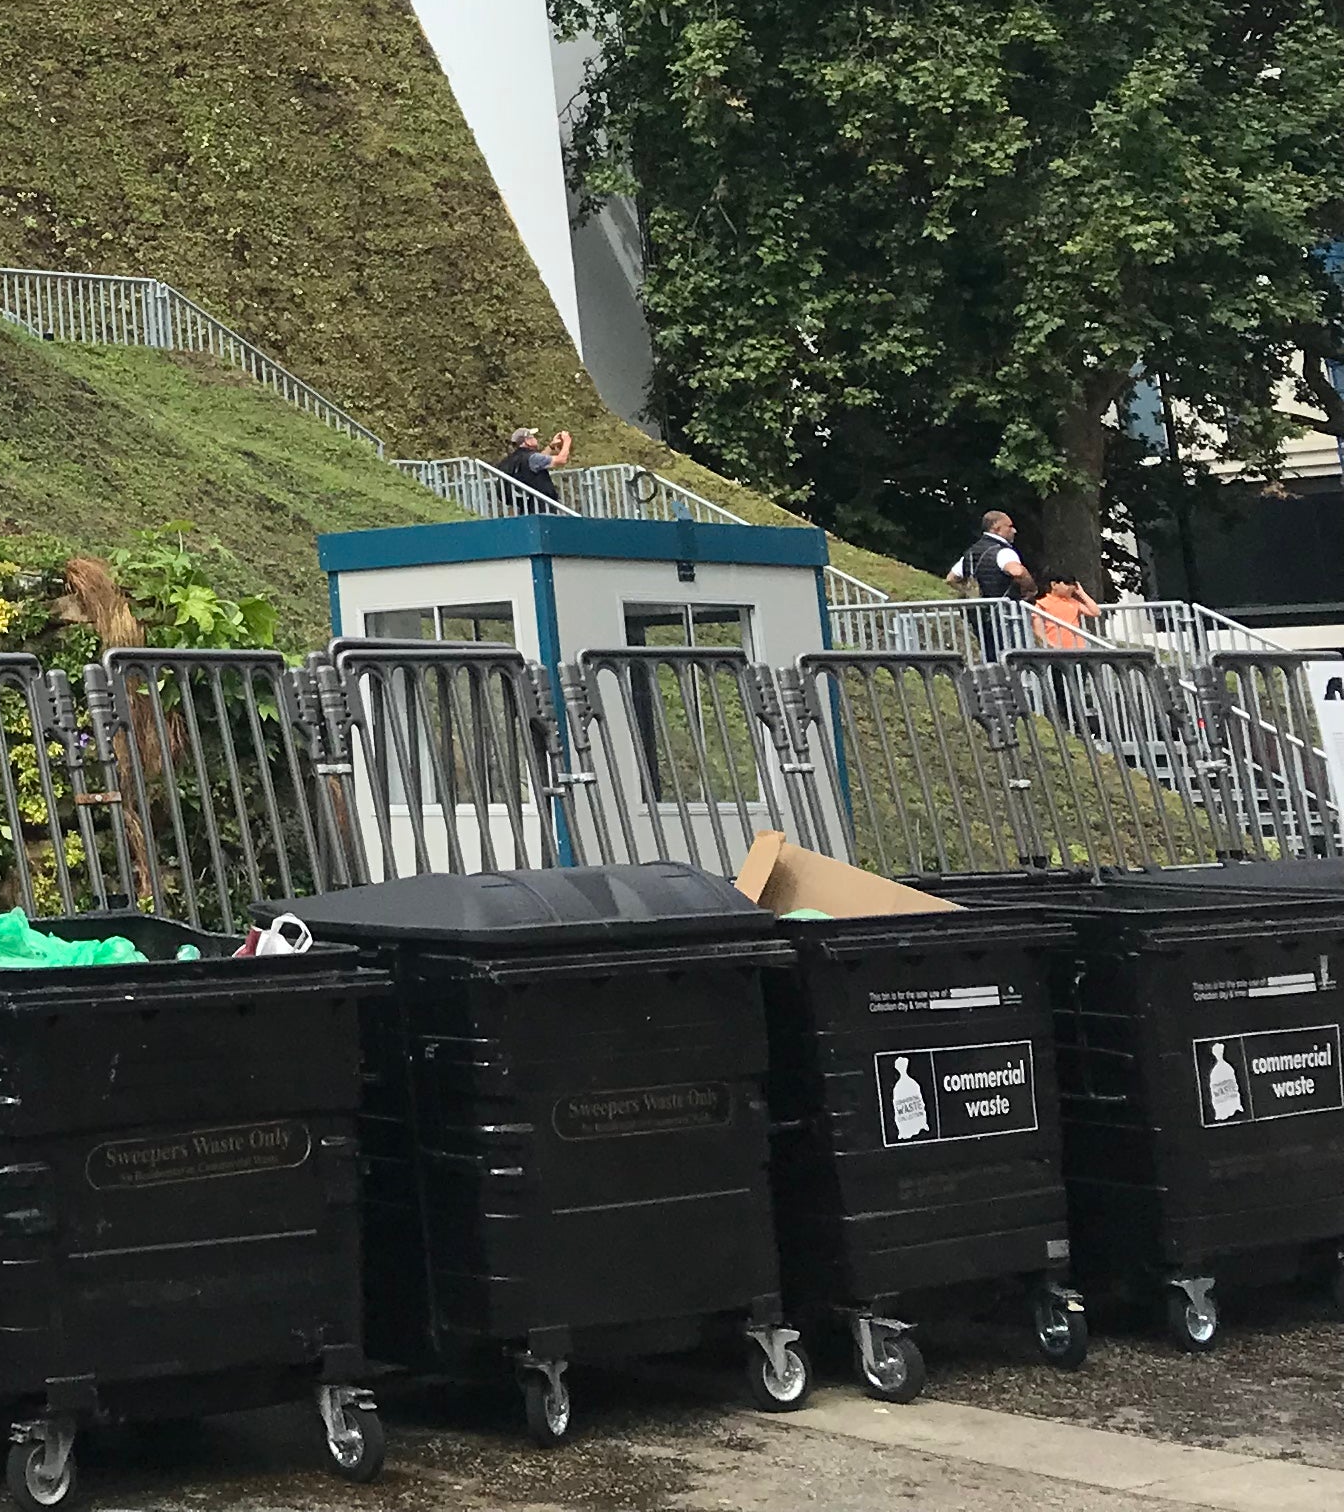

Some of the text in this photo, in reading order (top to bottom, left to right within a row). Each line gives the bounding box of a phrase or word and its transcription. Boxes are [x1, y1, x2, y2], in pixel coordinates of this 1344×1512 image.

[1252, 1042, 1332, 1074] commercial
[943, 1059, 1026, 1092] commercial
[1272, 1076, 1315, 1098] waste
[568, 1088, 718, 1120] Sweepers Waste Only
[896, 1099, 923, 1115] WASTE
[965, 1094, 1010, 1118] waste
[106, 1128, 291, 1169] Sweepers Waste Only
